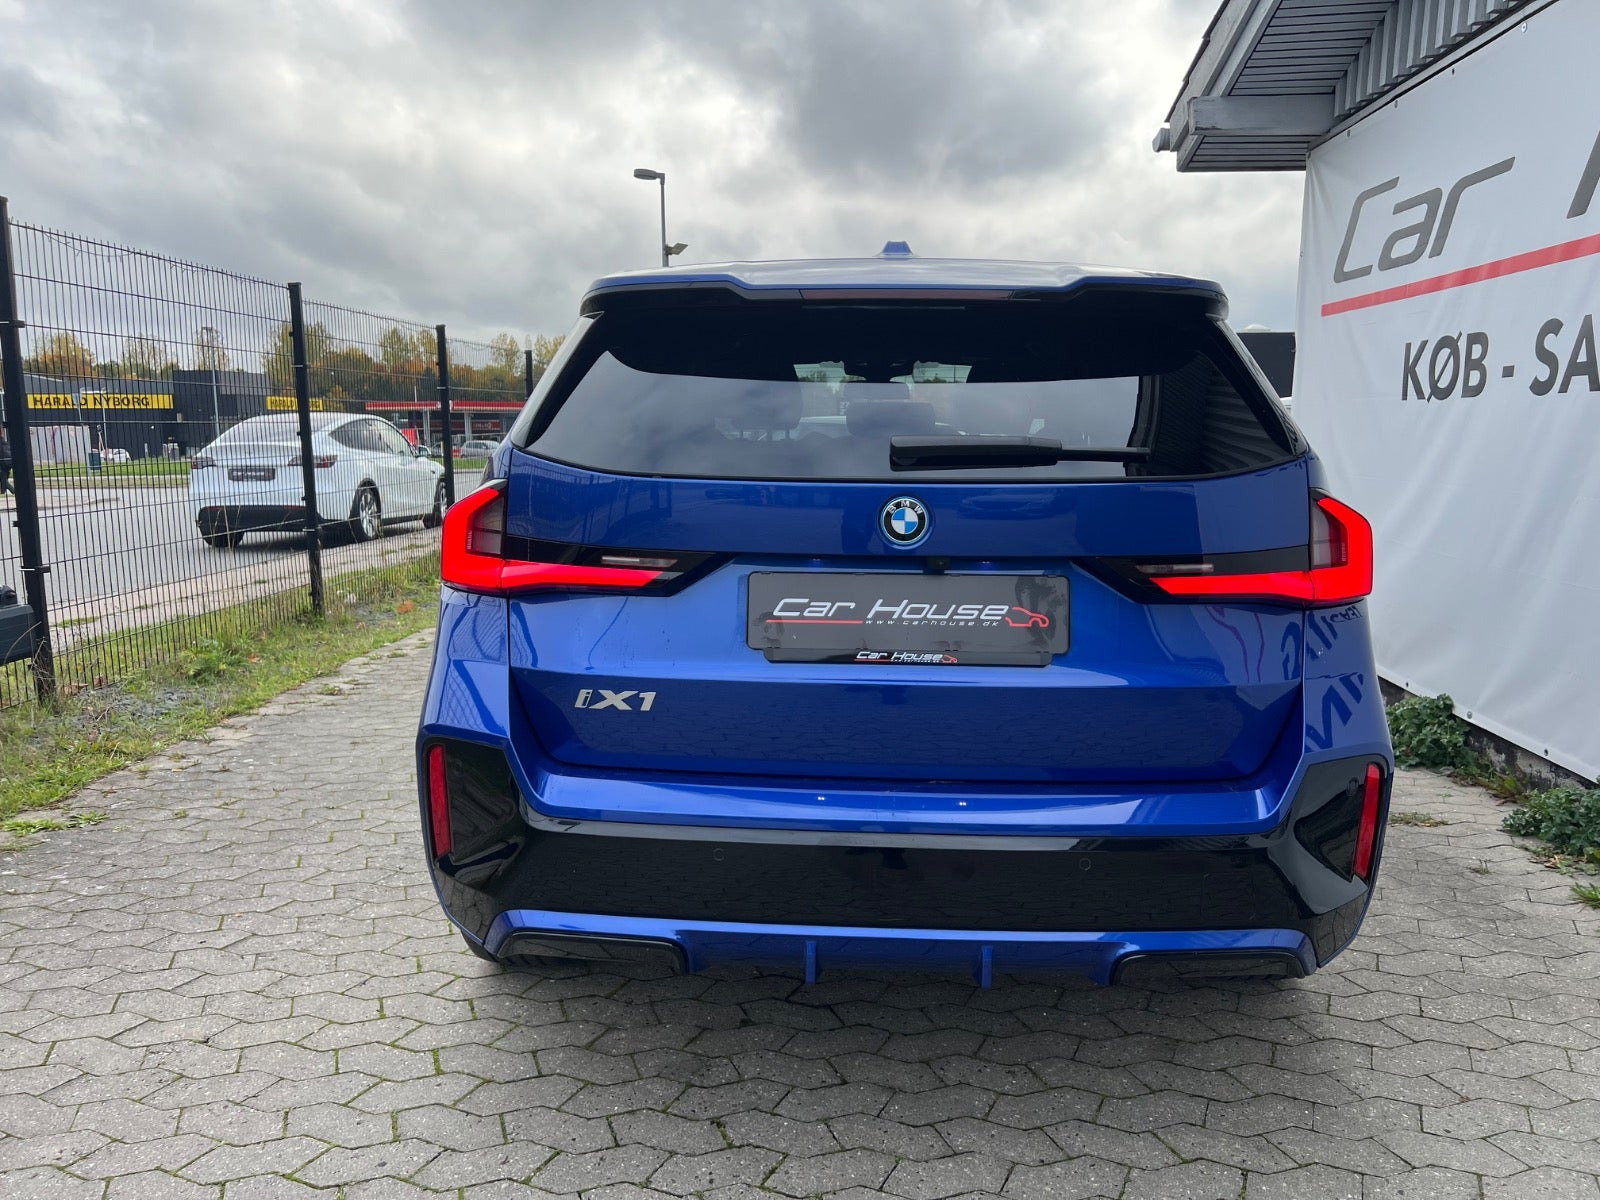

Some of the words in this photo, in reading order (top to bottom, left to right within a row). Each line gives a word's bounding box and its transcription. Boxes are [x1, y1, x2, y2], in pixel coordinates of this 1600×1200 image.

[1333, 156, 1516, 284] Car
[1401, 330, 1489, 403] KØB
[93, 396, 150, 406] NYBORG
[888, 500, 923, 514] BMW
[773, 598, 856, 617] Car
[866, 599, 1009, 620] House
[856, 651, 888, 659] Car
[891, 651, 943, 661] House
[574, 689, 657, 711] iX1
